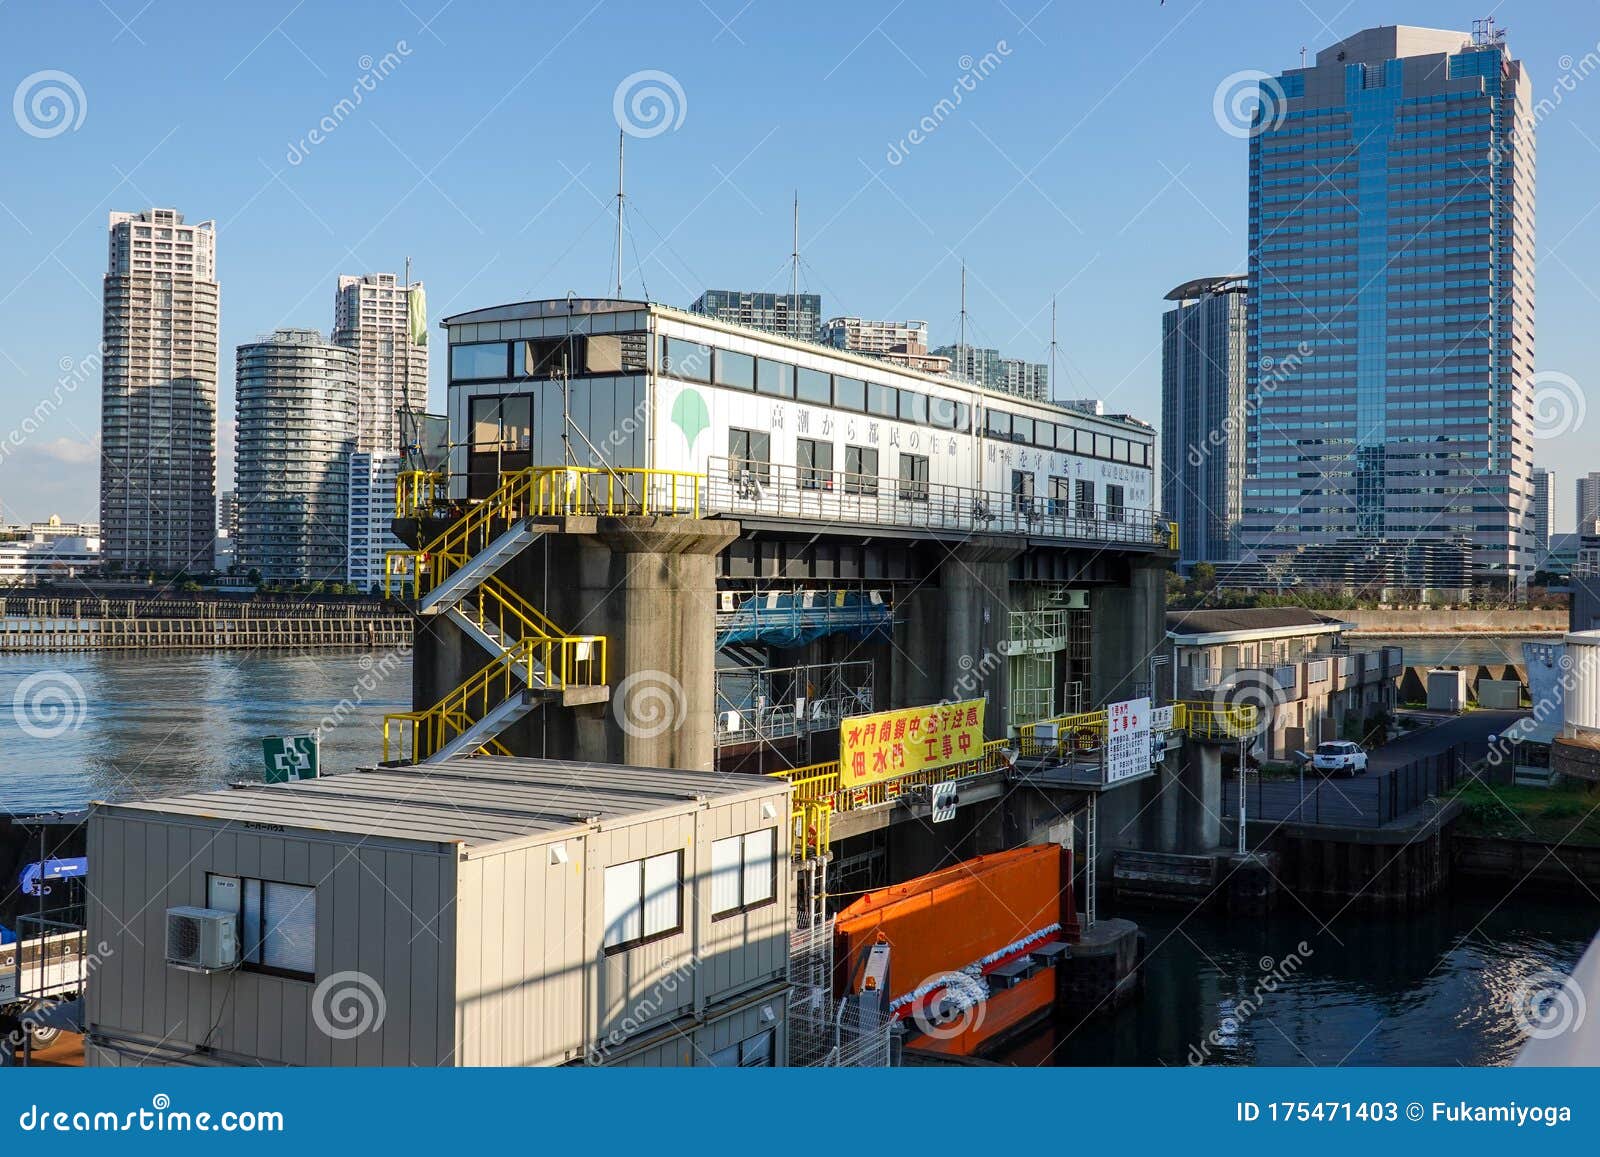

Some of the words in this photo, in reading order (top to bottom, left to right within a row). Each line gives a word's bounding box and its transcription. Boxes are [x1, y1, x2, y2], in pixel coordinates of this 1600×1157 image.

[851, 743, 905, 778] 佃水門
[924, 731, 971, 762] 工事中
